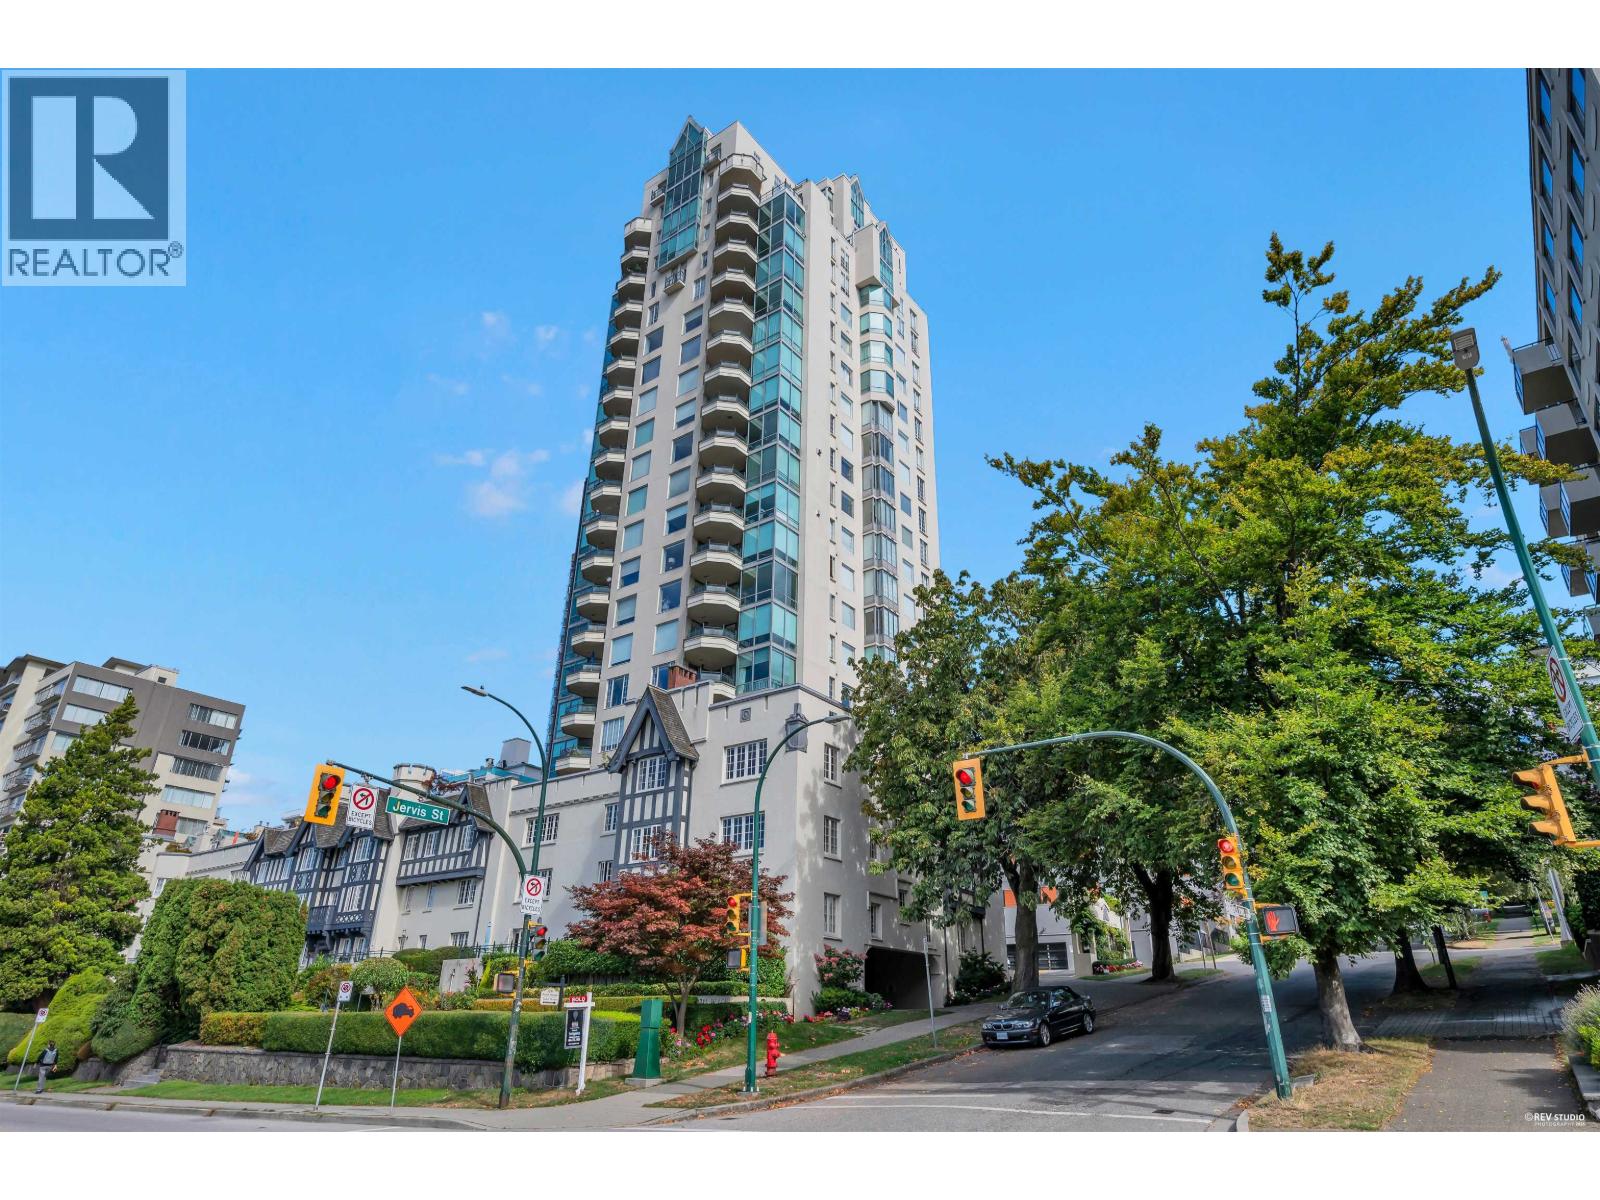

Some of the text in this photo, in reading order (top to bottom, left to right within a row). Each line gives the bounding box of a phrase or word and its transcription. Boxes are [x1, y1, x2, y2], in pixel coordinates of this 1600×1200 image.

[351, 810, 371, 819] EXCEPT
[392, 801, 444, 821] Jervis St
